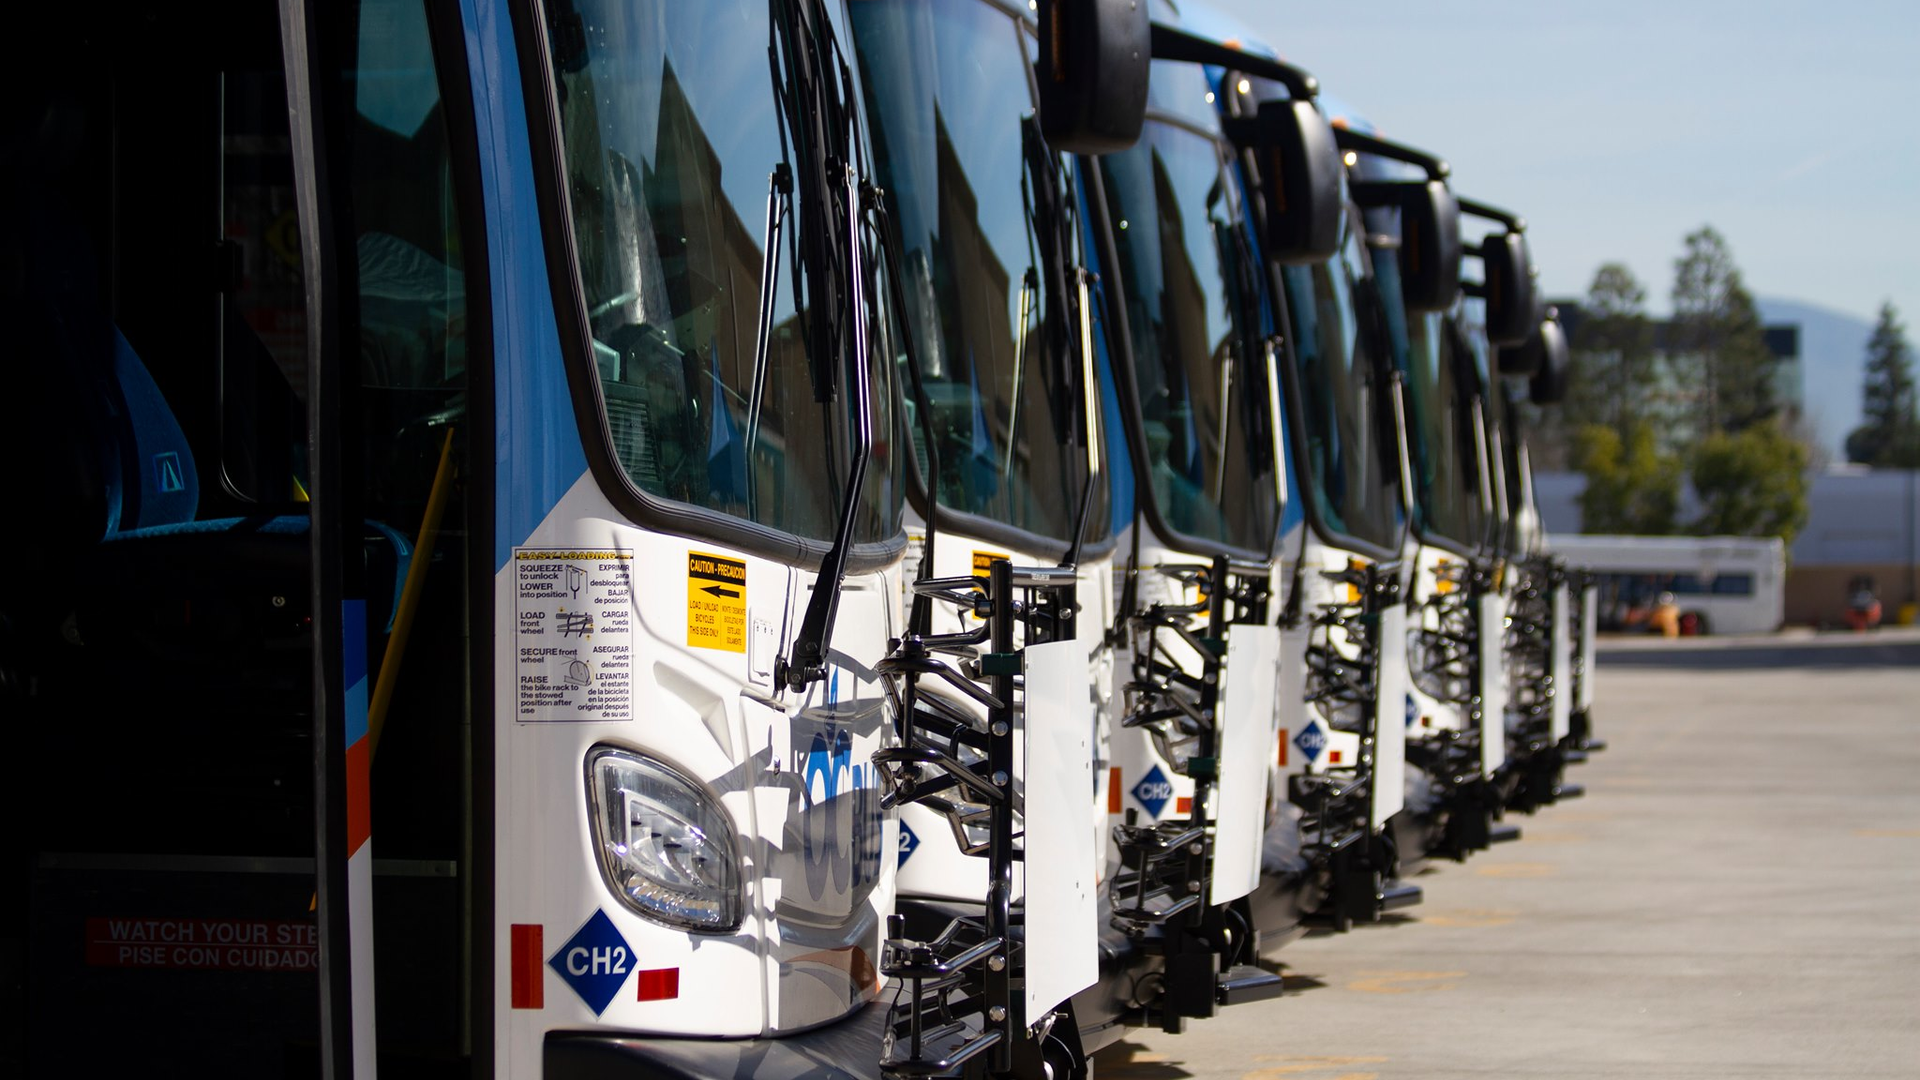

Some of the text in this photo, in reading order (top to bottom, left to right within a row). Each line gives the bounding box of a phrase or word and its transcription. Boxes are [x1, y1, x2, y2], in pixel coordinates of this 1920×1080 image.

[520, 552, 556, 560] EASY
[561, 552, 616, 560] LOADING
[690, 559, 714, 574] CAUTION
[690, 600, 701, 609] LOAD
[704, 602, 718, 612] UNLOAD
[695, 614, 714, 624] BICYCLES
[690, 626, 718, 637] THIS SIDE ONLY
[1140, 782, 1171, 800] CH2
[108, 920, 318, 945] WATCH YOUR STE
[118, 946, 166, 966] PISE
[172, 946, 221, 967] CON
[566, 946, 627, 976] CH2
